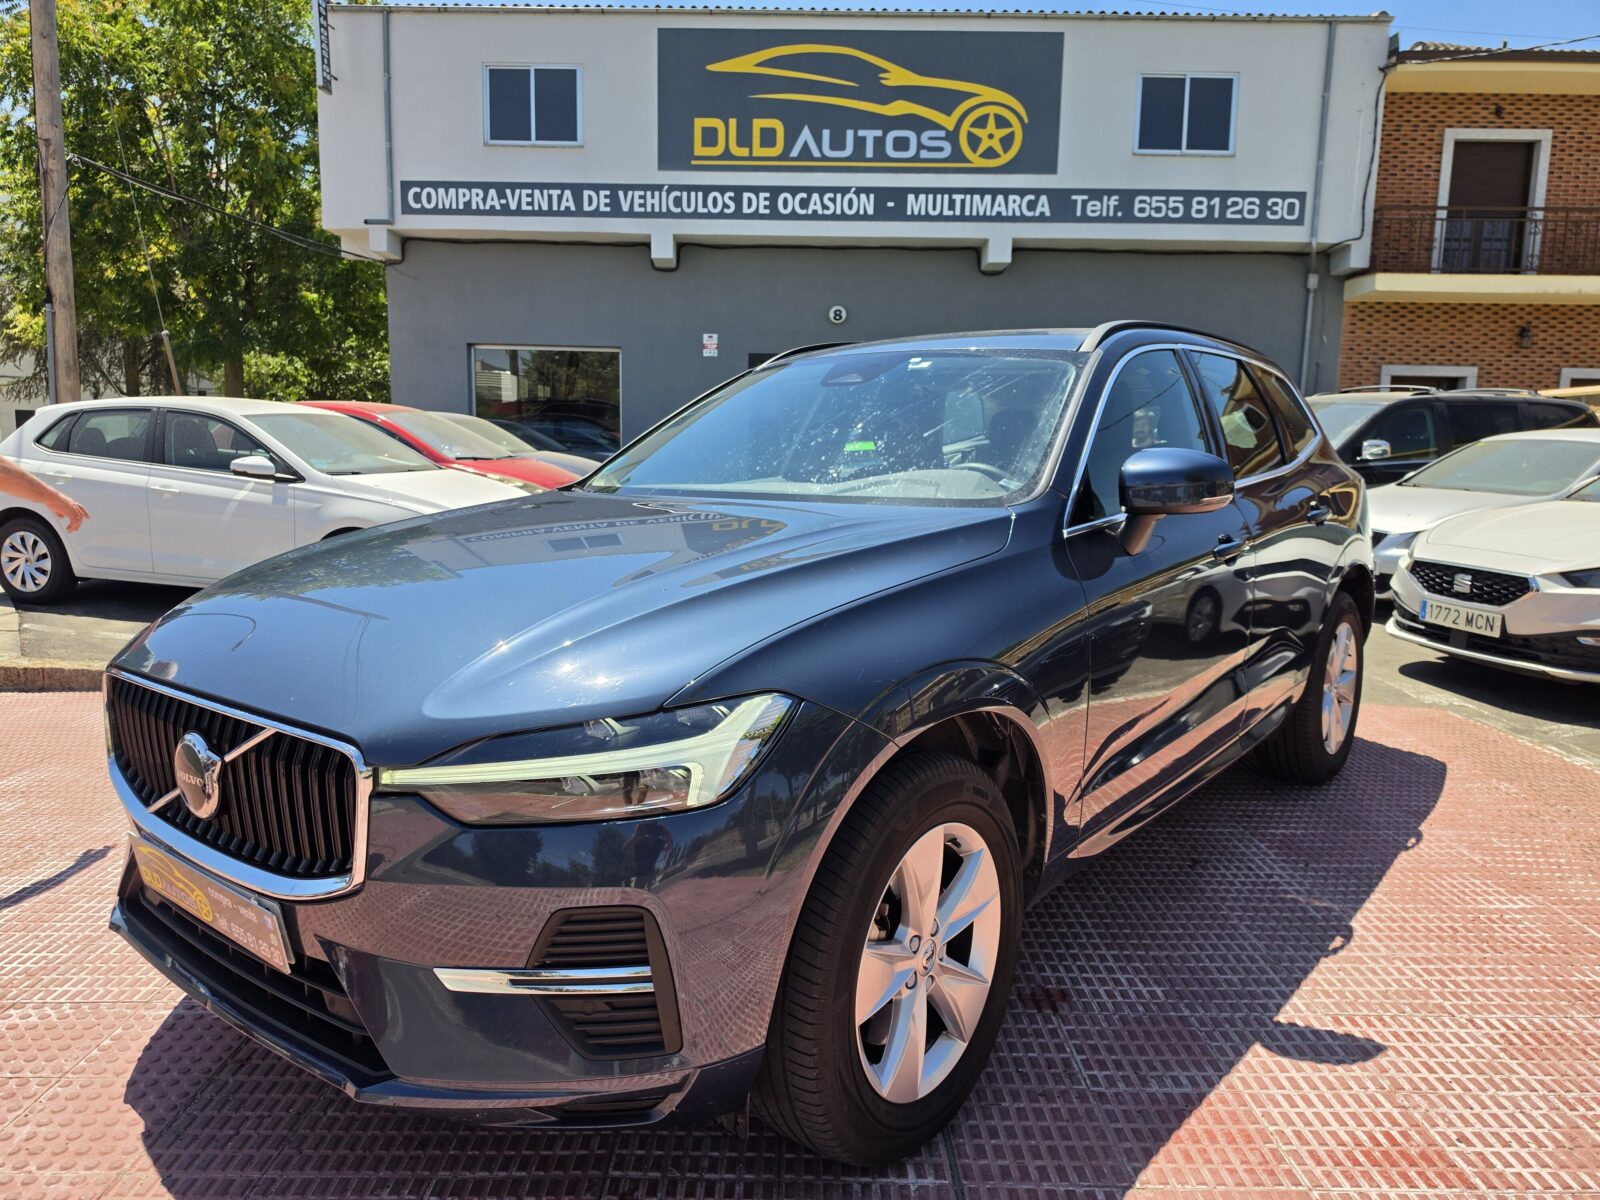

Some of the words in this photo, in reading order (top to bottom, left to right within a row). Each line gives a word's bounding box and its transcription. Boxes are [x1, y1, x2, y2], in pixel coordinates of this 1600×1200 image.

[693, 117, 785, 158] DLD
[789, 124, 952, 159] AUTOS
[407, 186, 576, 212] COMPRA-VENTA
[582, 189, 611, 212] DE
[618, 185, 735, 214] VEHÍCULOS
[742, 192, 771, 215] DE
[777, 187, 875, 216] OCASIÓN
[906, 193, 1051, 217] MULTIMARCA
[1071, 195, 1123, 217] Telf.
[1133, 195, 1184, 218] 655
[1266, 198, 1300, 220] 30
[833, 309, 843, 321] 8
[1429, 603, 1460, 625] 1772
[1465, 611, 1495, 632] MCN
